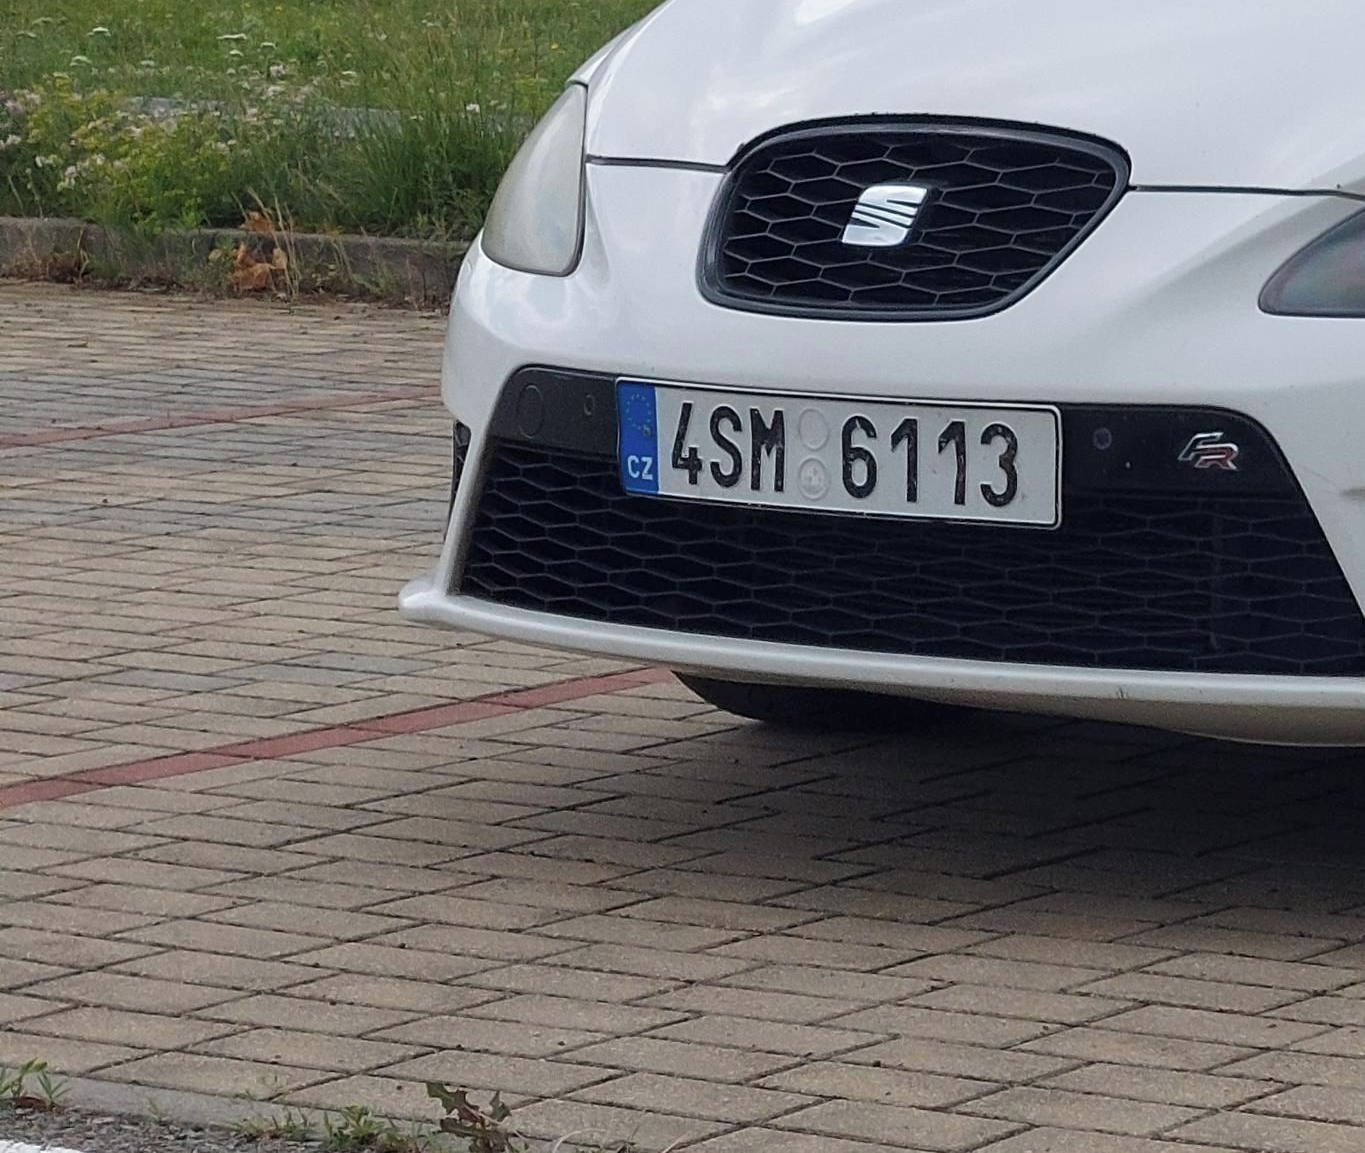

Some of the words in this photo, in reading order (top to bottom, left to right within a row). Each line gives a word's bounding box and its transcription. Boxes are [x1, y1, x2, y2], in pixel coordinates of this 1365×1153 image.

[627, 455, 653, 480] CZ
[671, 401, 785, 493] 4SM
[840, 414, 1018, 508] 6113
[1177, 431, 1239, 471] FR
